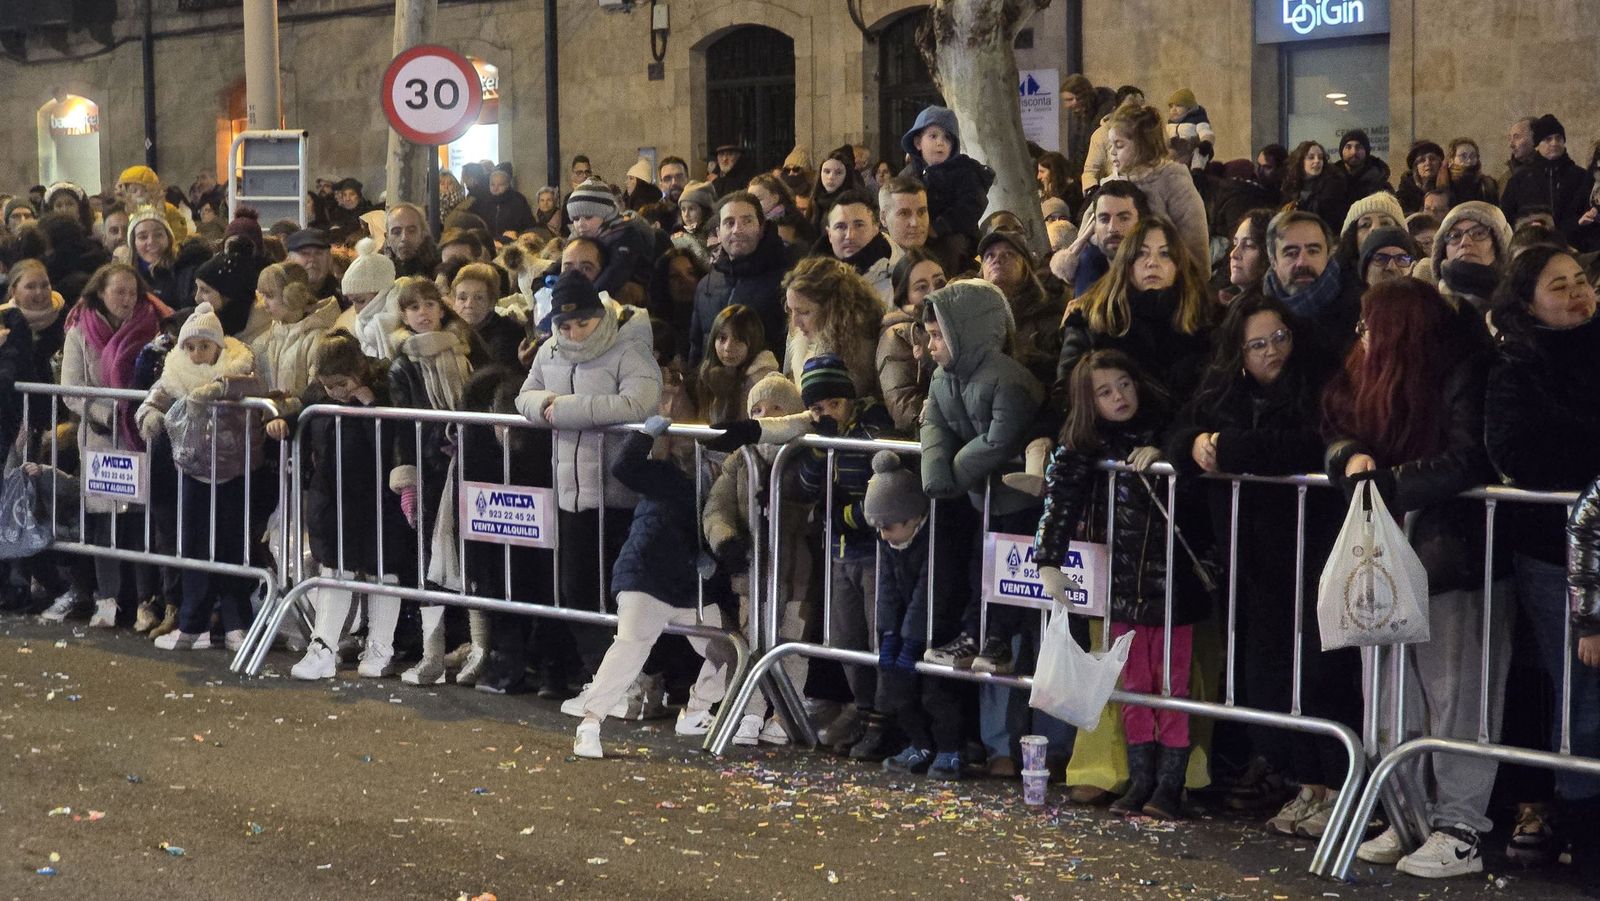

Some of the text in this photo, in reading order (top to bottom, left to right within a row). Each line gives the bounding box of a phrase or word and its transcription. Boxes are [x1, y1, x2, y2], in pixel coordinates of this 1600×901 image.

[405, 78, 459, 110] 30
[102, 455, 133, 470] METSA
[489, 492, 535, 509] METSA
[489, 510, 535, 522] 923 22 45 24
[473, 521, 538, 537] VENTA Y ALQUILER
[1023, 568, 1040, 579] 923
[1071, 574, 1084, 584] 24
[1002, 582, 1031, 596] VENTA
[1032, 586, 1039, 597] Y
